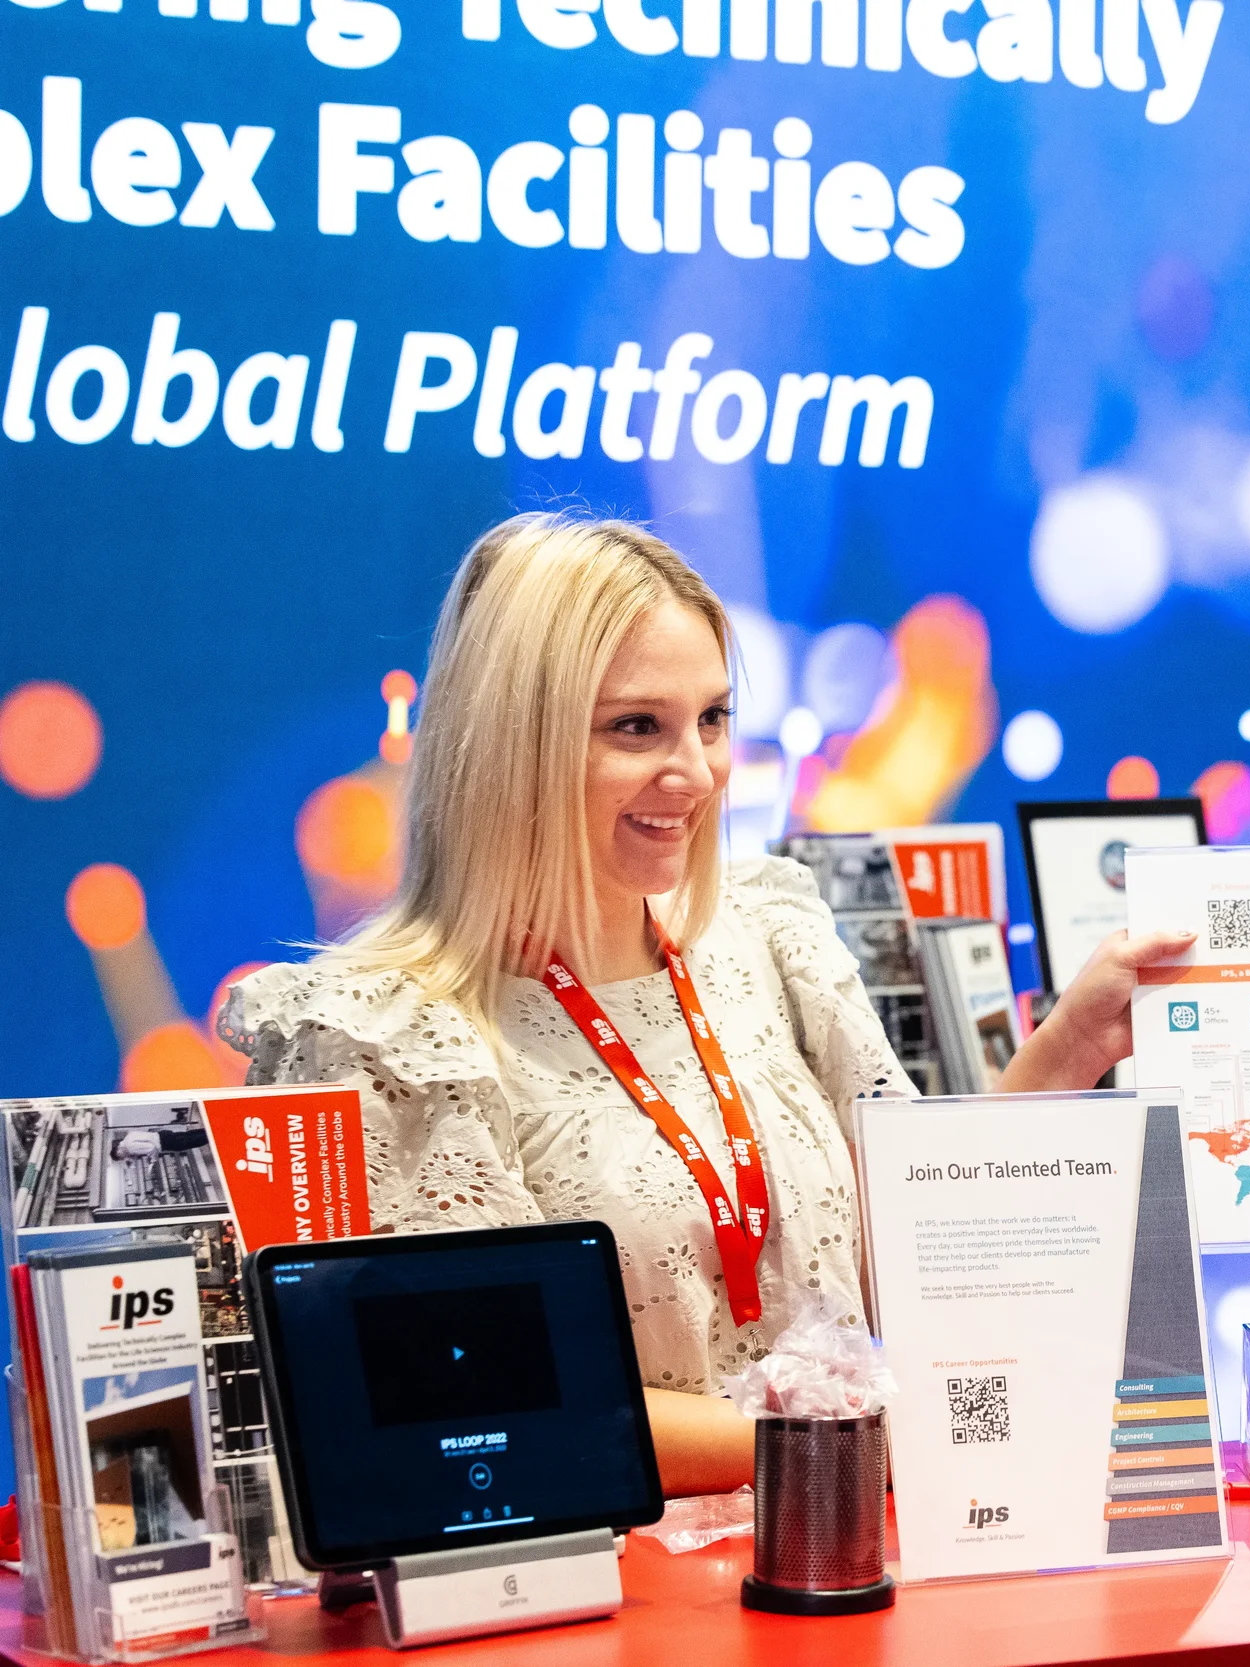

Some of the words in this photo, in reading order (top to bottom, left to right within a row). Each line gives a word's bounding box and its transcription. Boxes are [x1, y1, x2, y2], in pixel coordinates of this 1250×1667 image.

[318, 102, 966, 269] Facilities
[3, 306, 357, 452] lobal
[384, 326, 935, 469] Platform
[316, 1112, 328, 1157] Facilities
[333, 1111, 343, 1141] Globe
[236, 1116, 273, 1174] ips
[335, 1143, 345, 1161] the
[731, 1134, 751, 1167] ips
[287, 1114, 310, 1212] OVERVIEW
[905, 1164, 943, 1181] Join
[948, 1163, 980, 1179] Our
[984, 1159, 1060, 1178] Talented
[1065, 1159, 1117, 1175] Team.
[320, 1159, 333, 1204] Complex
[335, 1162, 348, 1199] Around
[715, 1196, 735, 1227] ips
[746, 1204, 765, 1237] ips
[1001, 1216, 1018, 1224] work
[949, 1230, 975, 1239] positive
[1012, 1227, 1043, 1235] everyday
[1006, 1239, 1023, 1247] pride
[1025, 1238, 1062, 1246] themselves
[1072, 1236, 1100, 1244] knowing
[951, 1253, 966, 1261] help
[1005, 1250, 1031, 1258] develop
[1048, 1248, 1090, 1256] manufacture
[919, 1265, 966, 1273] life-impacting
[968, 1263, 1000, 1272] products.
[109, 1275, 174, 1330] ips
[945, 1360, 968, 1368] Career
[969, 1357, 1018, 1367] Opportunities
[1119, 1383, 1154, 1391] Consulting
[1117, 1407, 1157, 1416] Architecture
[1115, 1432, 1154, 1442] Engineering
[1112, 1456, 1136, 1465] Project
[1138, 1455, 1165, 1464] Controls
[1110, 1480, 1152, 1490] Construction
[1153, 1478, 1195, 1487] Management
[969, 1498, 1009, 1529] ips
[1108, 1506, 1127, 1514] CGMP
[1128, 1505, 1165, 1514] Compliance
[1170, 1503, 1184, 1511] CQV
